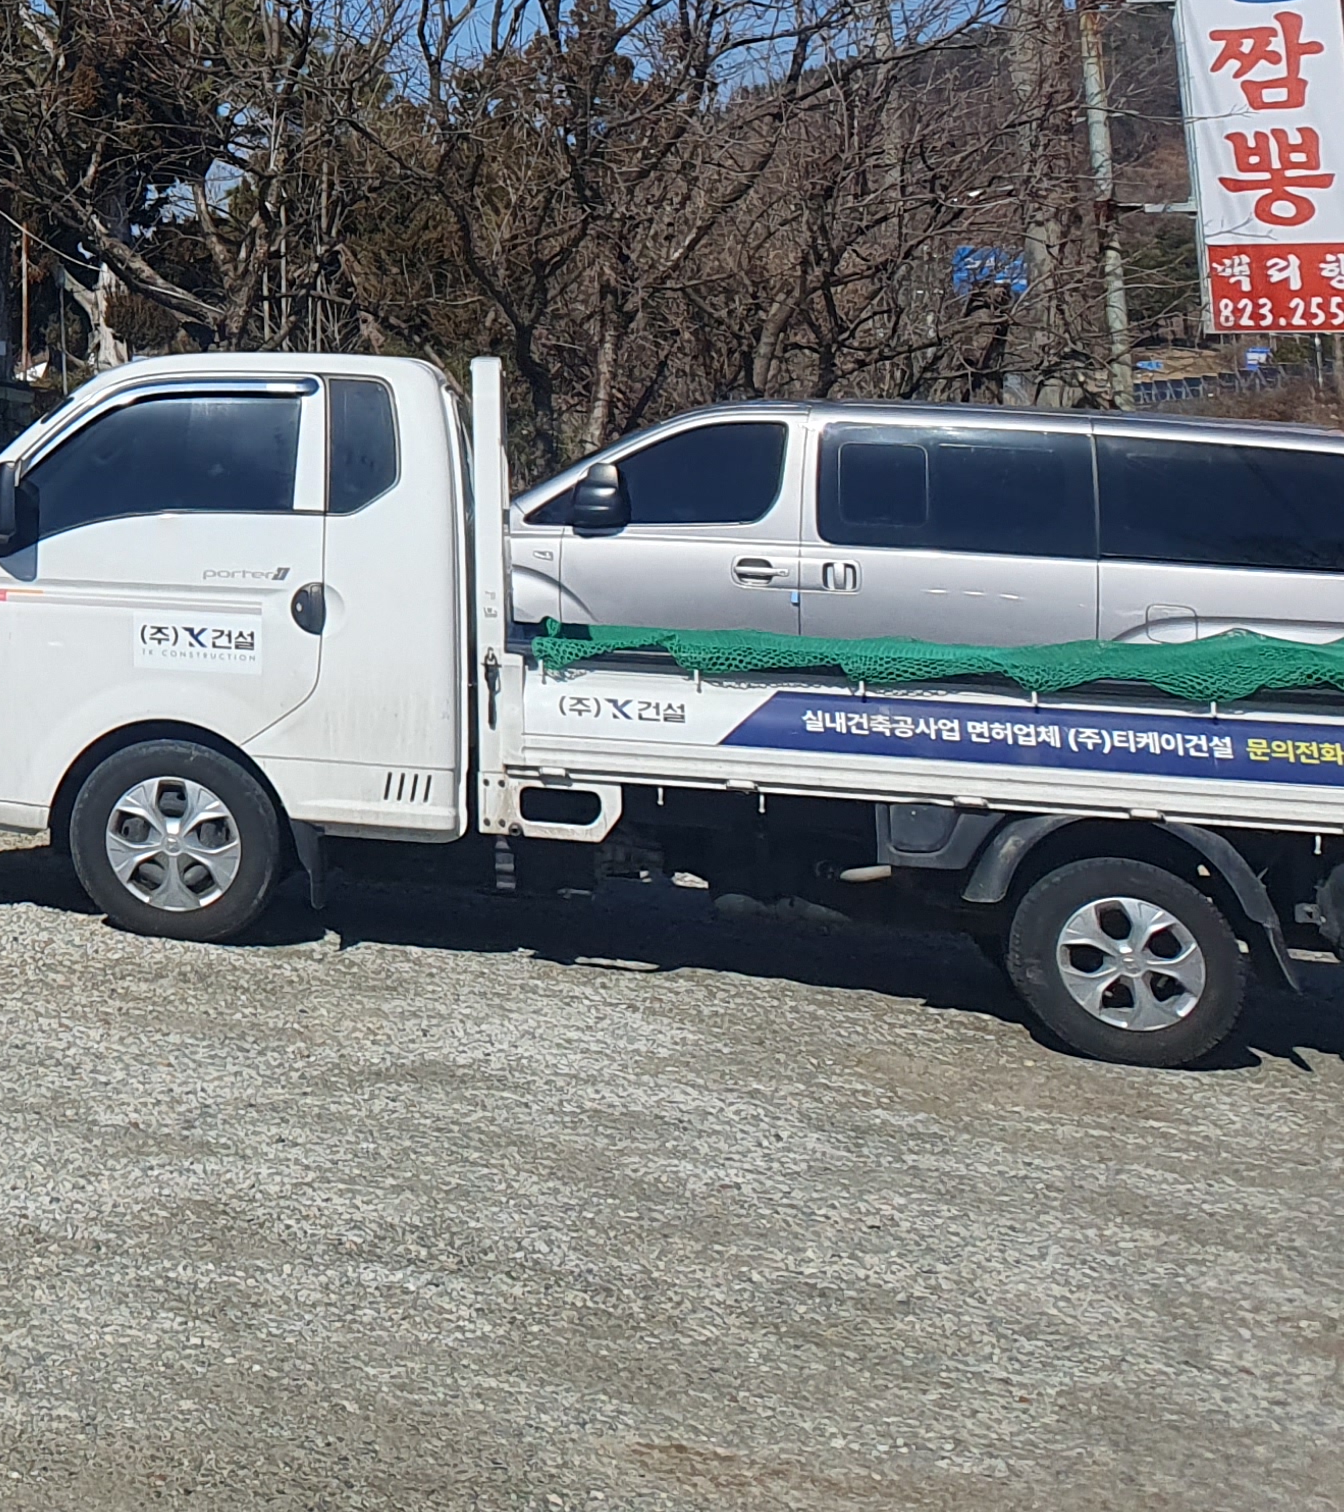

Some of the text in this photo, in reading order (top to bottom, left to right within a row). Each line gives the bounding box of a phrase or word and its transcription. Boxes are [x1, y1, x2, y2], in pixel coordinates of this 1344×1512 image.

[162, 648, 256, 662] CONSTRUCTION
[801, 708, 961, 742] 실내건축공사업
[966, 719, 1062, 749] 면허업체
[1068, 727, 1235, 759] (주)티케이건설
